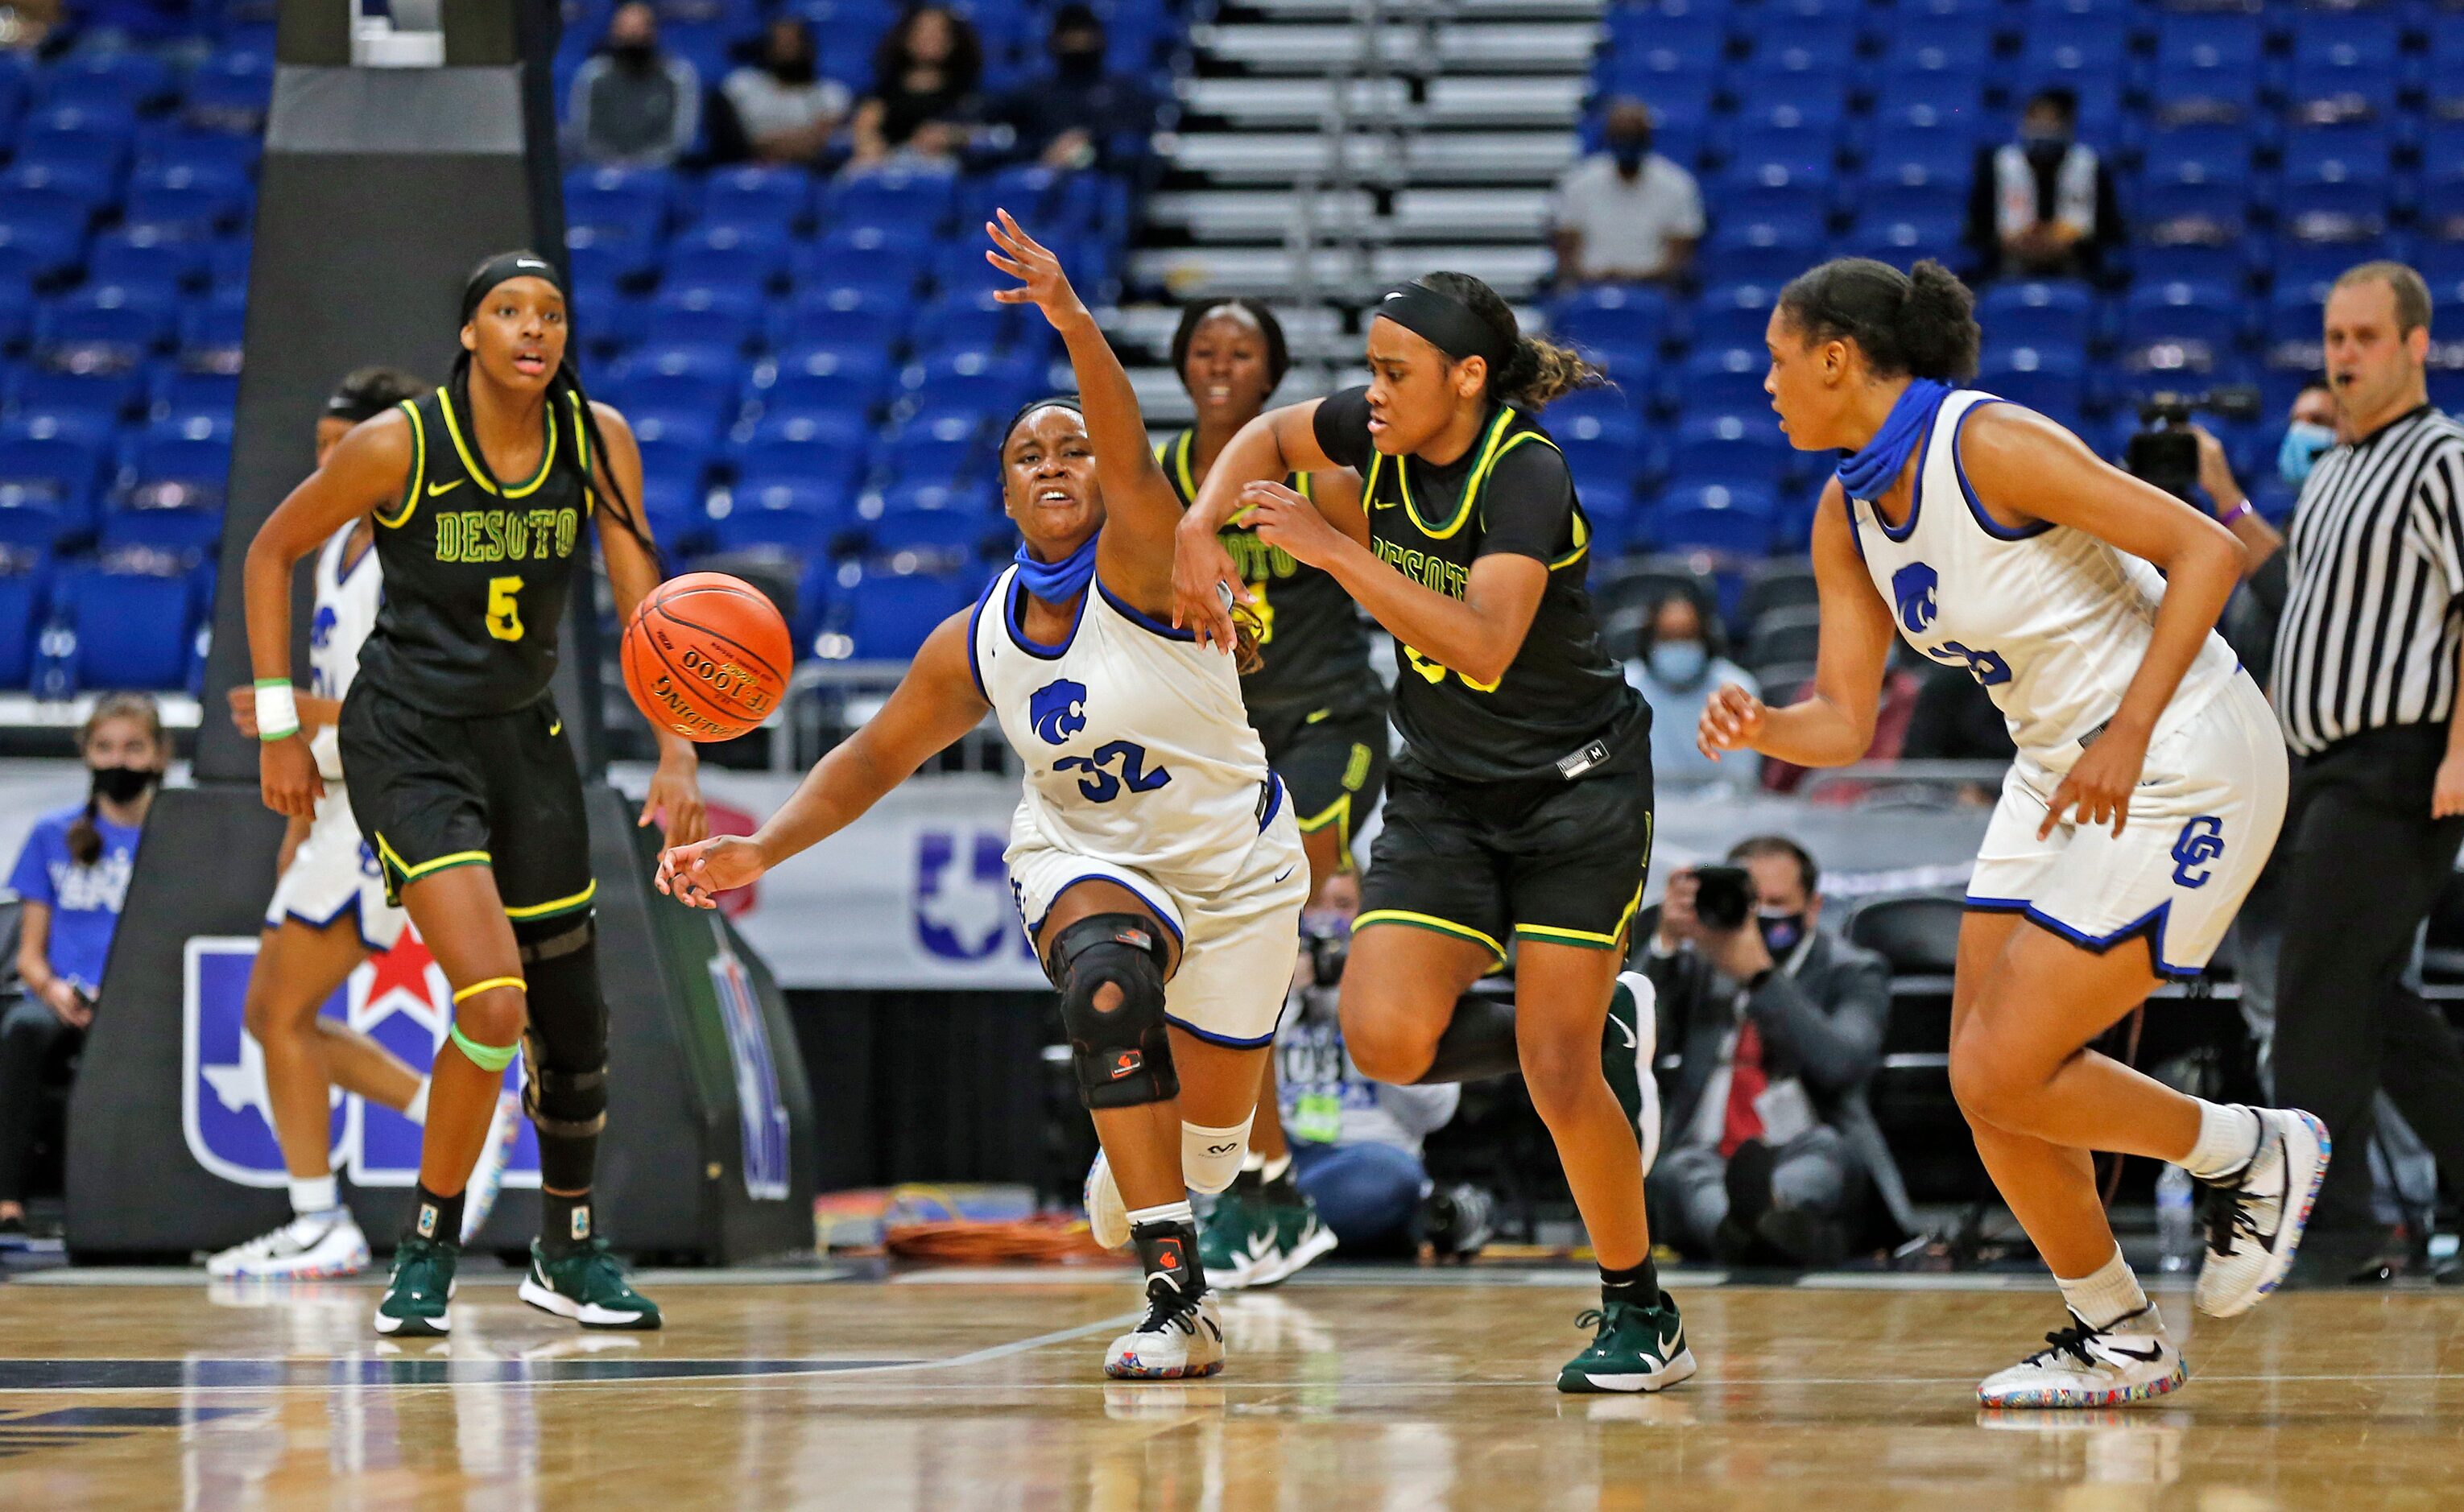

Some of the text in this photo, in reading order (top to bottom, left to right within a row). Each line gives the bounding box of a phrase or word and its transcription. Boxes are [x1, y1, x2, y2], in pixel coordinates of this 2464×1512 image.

[436, 508, 578, 563] DESOTO
[486, 576, 524, 641] 5
[1053, 740, 1172, 804] 32
[1590, 746, 1603, 760] M
